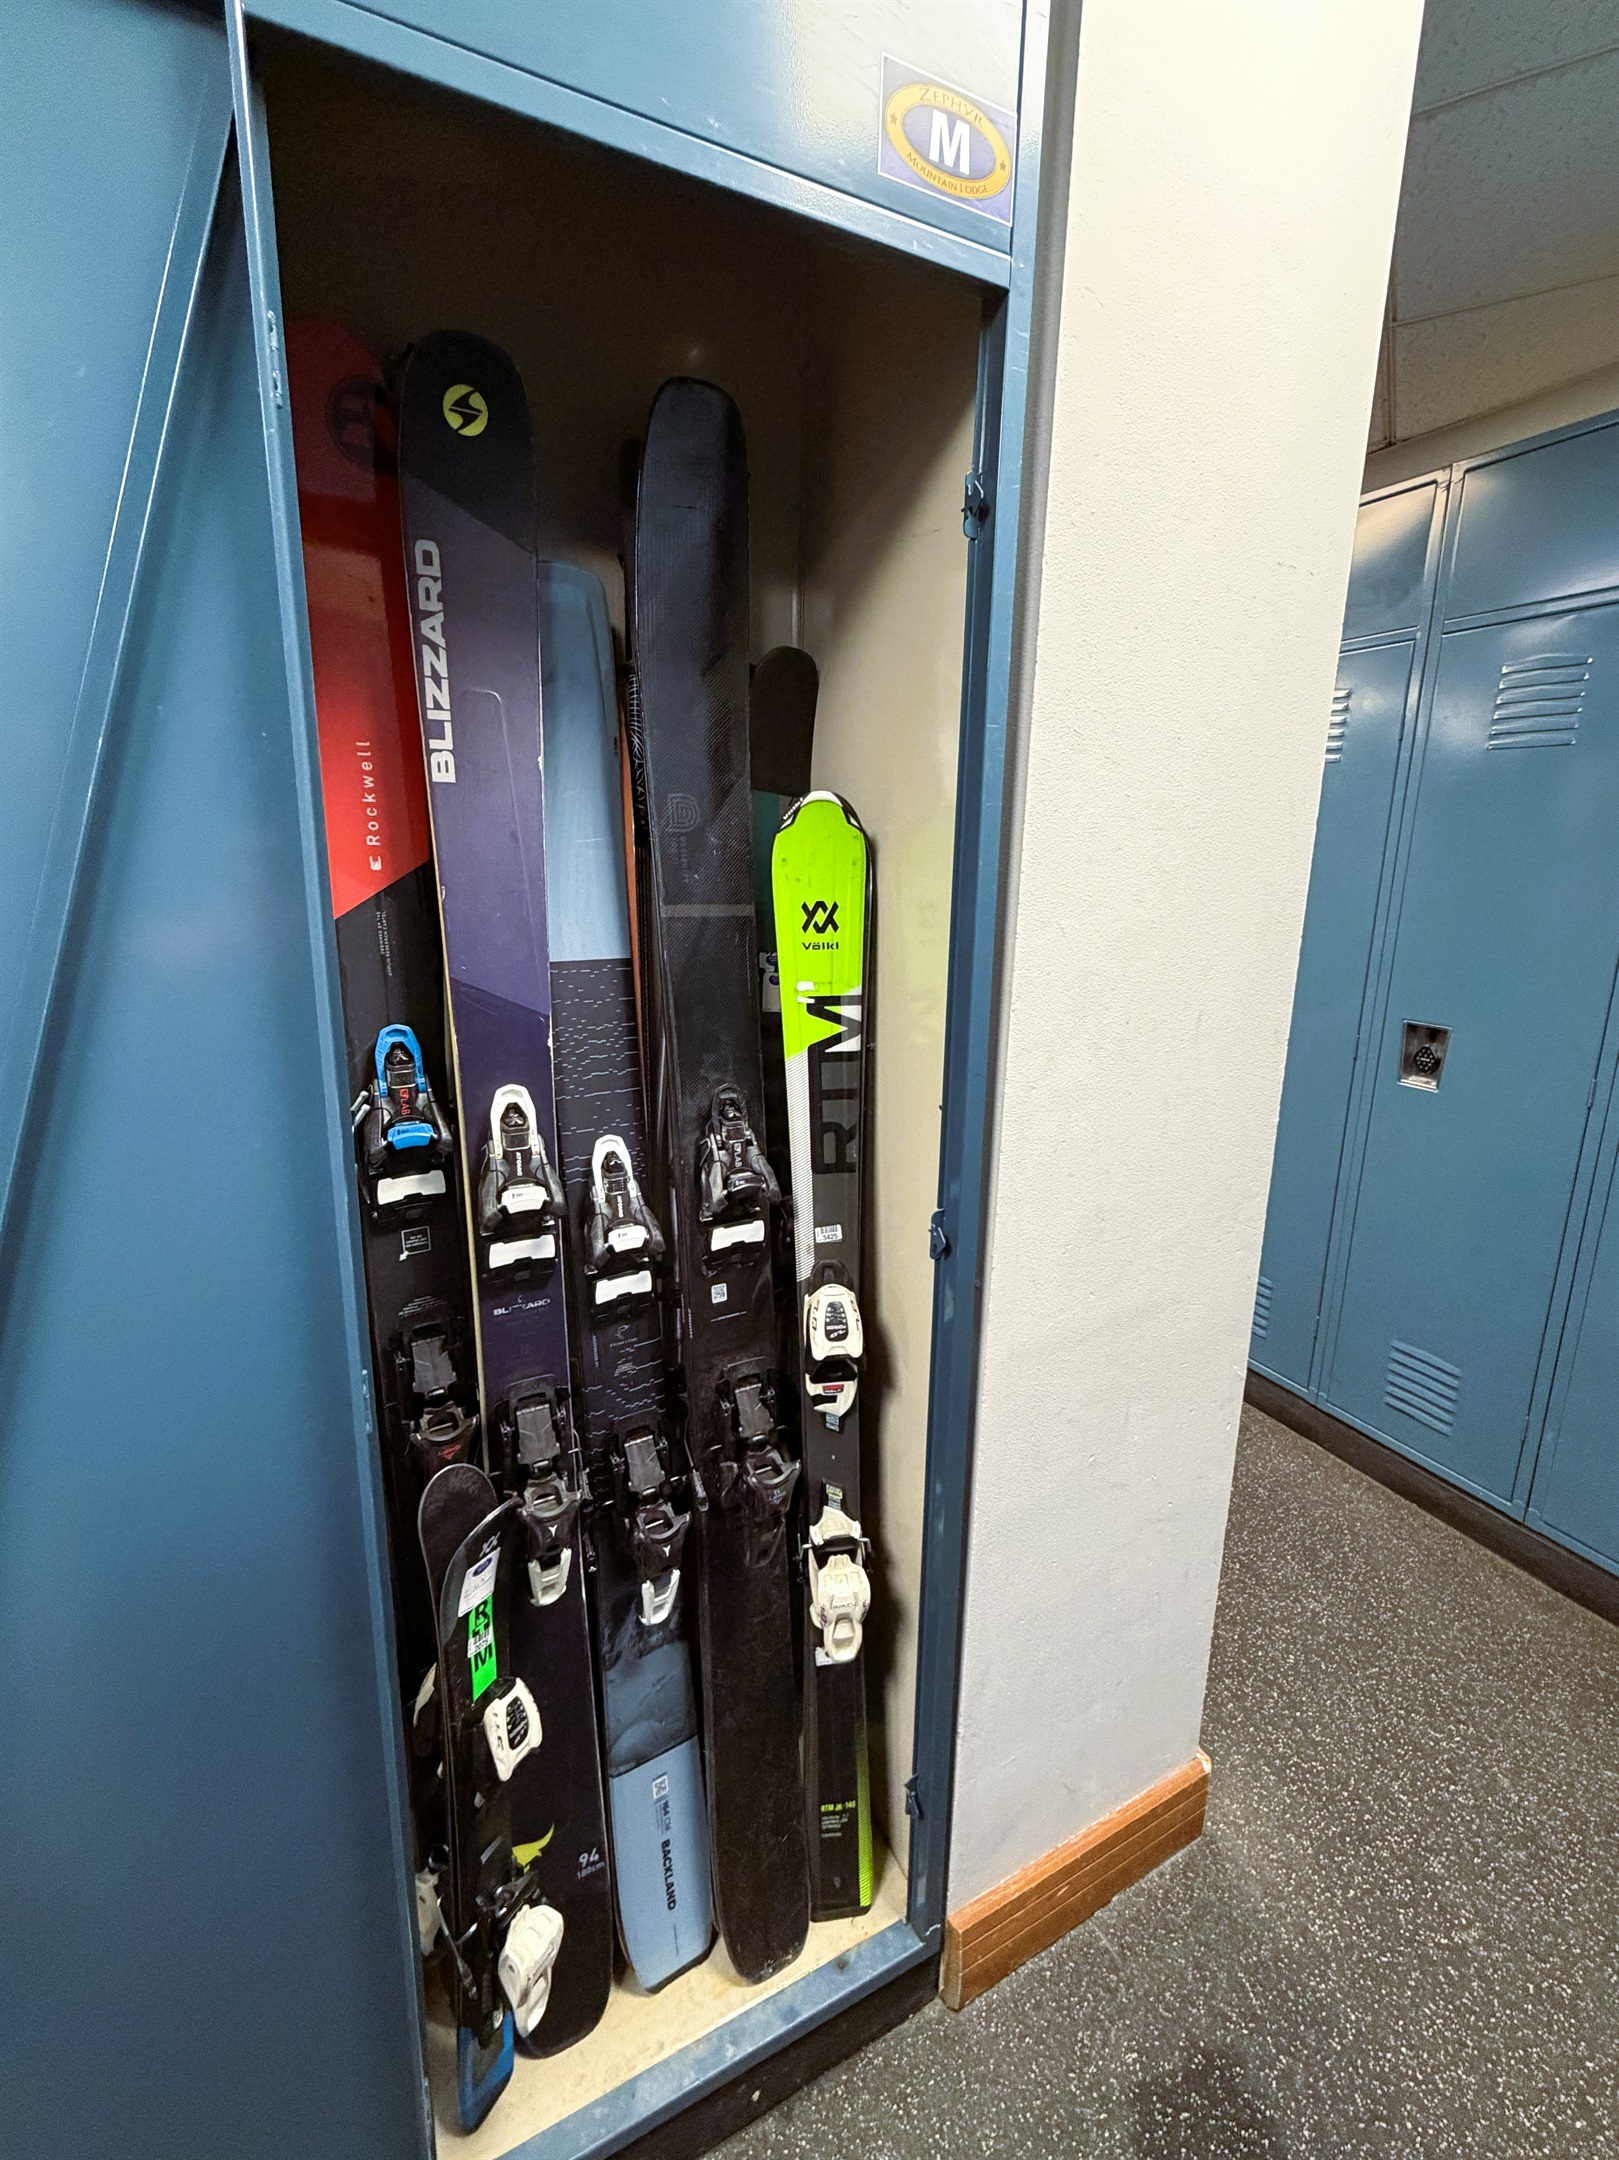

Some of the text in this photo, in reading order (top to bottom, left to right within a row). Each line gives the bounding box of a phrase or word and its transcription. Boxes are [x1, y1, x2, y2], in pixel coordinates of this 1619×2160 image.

[918, 87, 984, 128] ZEPHYR
[905, 151, 990, 195] MOUNTAIN LODGE
[928, 108, 971, 176] M
[414, 538, 456, 784] BLIZZARD
[355, 741, 381, 846] Rockwell
[802, 941, 840, 951] Völkl
[806, 994, 862, 1174] RTM
[578, 1847, 600, 1868] 94
[661, 1838, 677, 1912] BACKLAND
